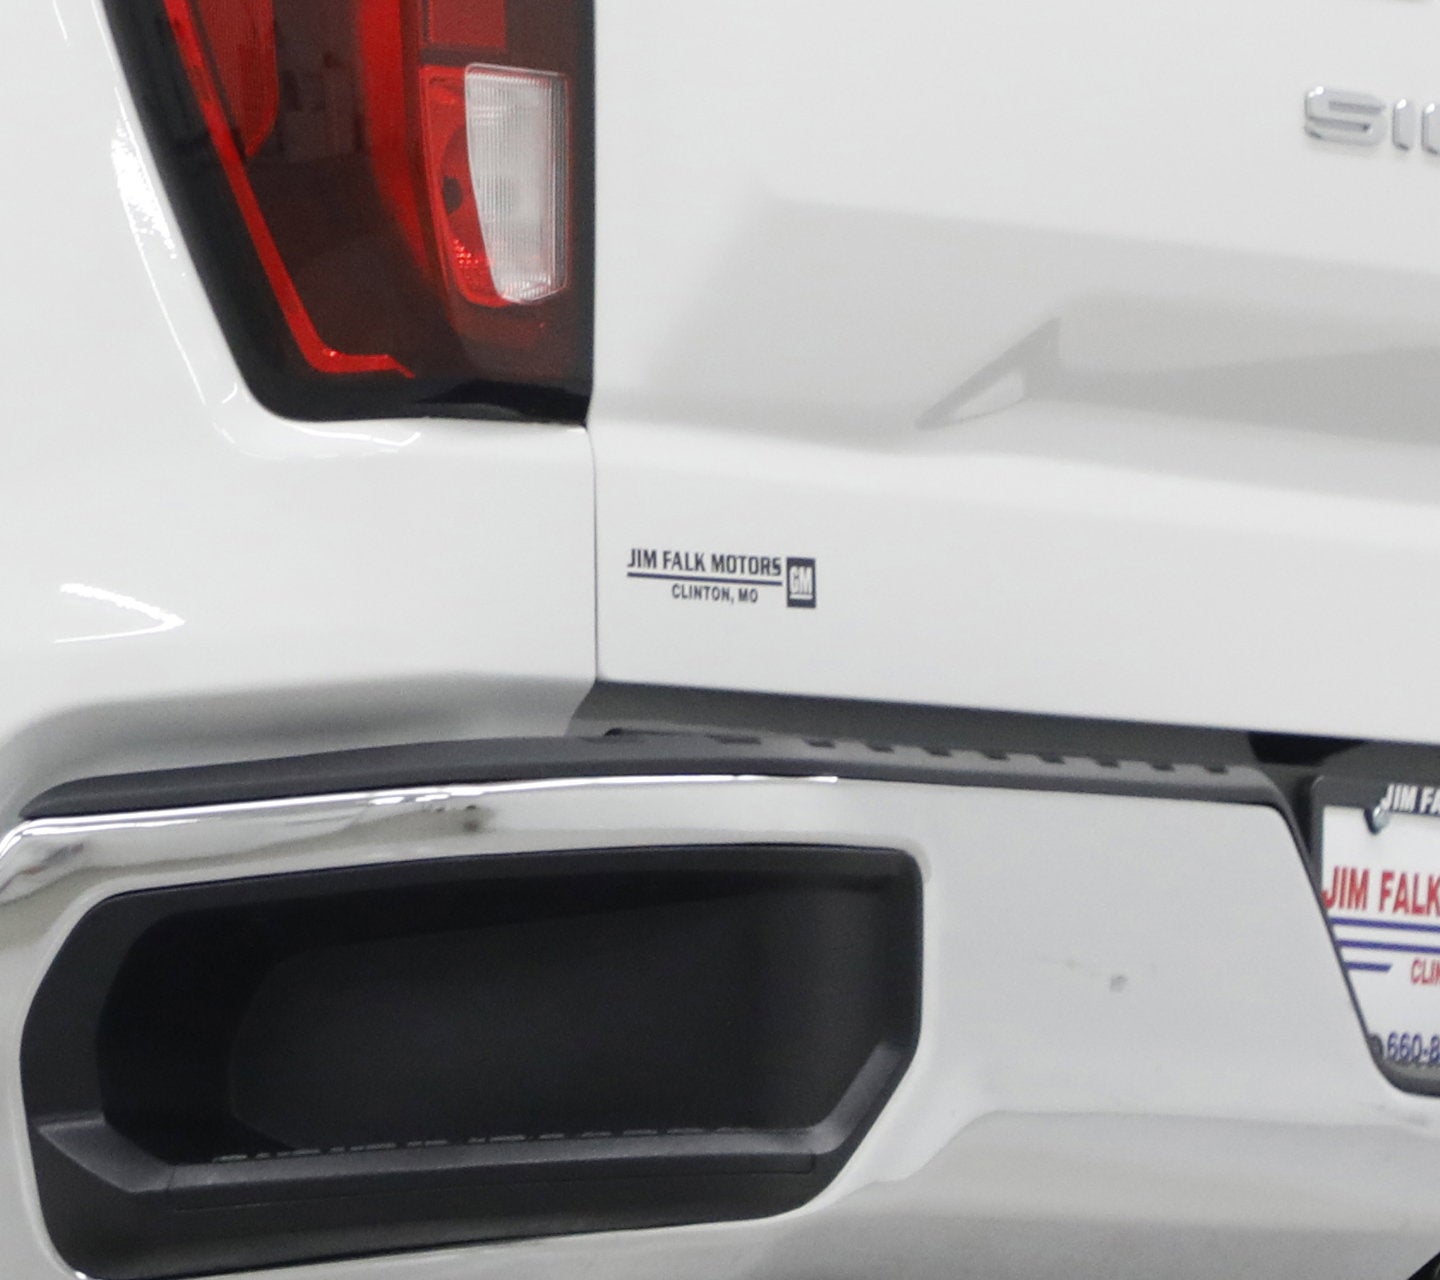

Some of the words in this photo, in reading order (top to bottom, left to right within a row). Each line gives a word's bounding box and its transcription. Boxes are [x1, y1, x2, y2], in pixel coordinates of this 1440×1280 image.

[627, 548, 657, 569] JIM
[662, 550, 706, 572] FALK
[711, 554, 782, 577] MOTORS
[672, 583, 735, 605] CLINTON,
[738, 587, 758, 603] MO
[1381, 784, 1415, 813] JIM
[1321, 866, 1369, 910] JIM
